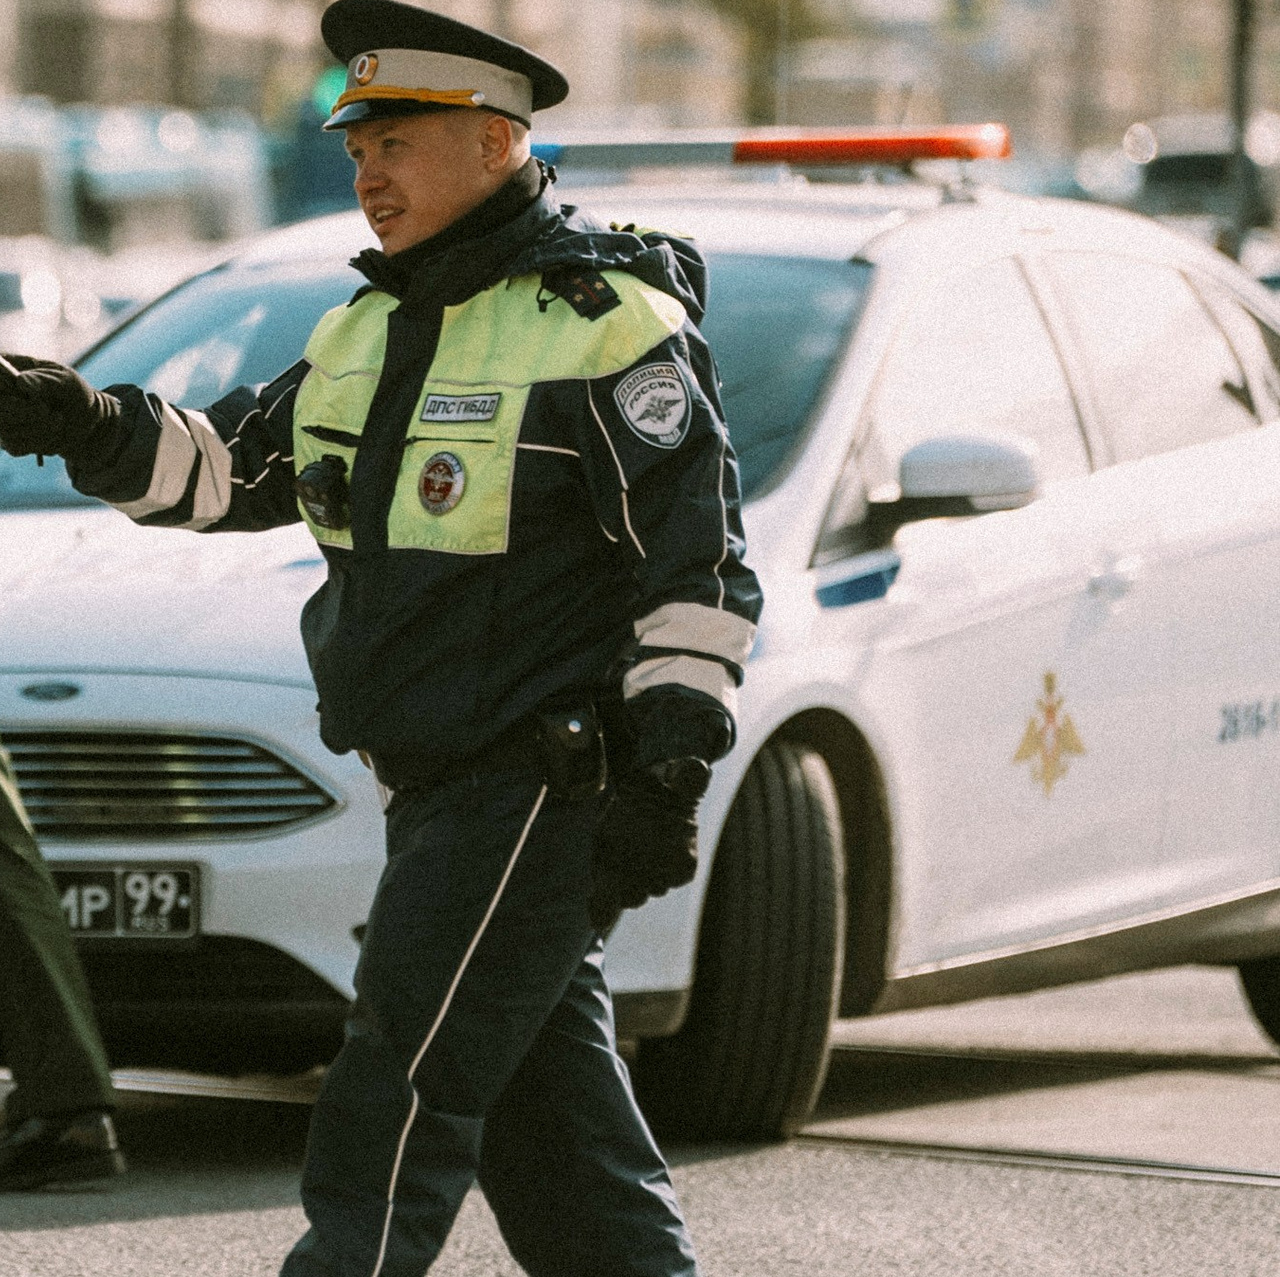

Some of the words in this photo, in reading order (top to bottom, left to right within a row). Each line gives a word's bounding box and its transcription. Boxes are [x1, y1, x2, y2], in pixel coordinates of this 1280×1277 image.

[620, 367, 675, 399] ПОЛИЦИЯ
[629, 380, 677, 411] РОССИЯ
[426, 400, 456, 416] ДПС
[125, 873, 178, 916] 99
